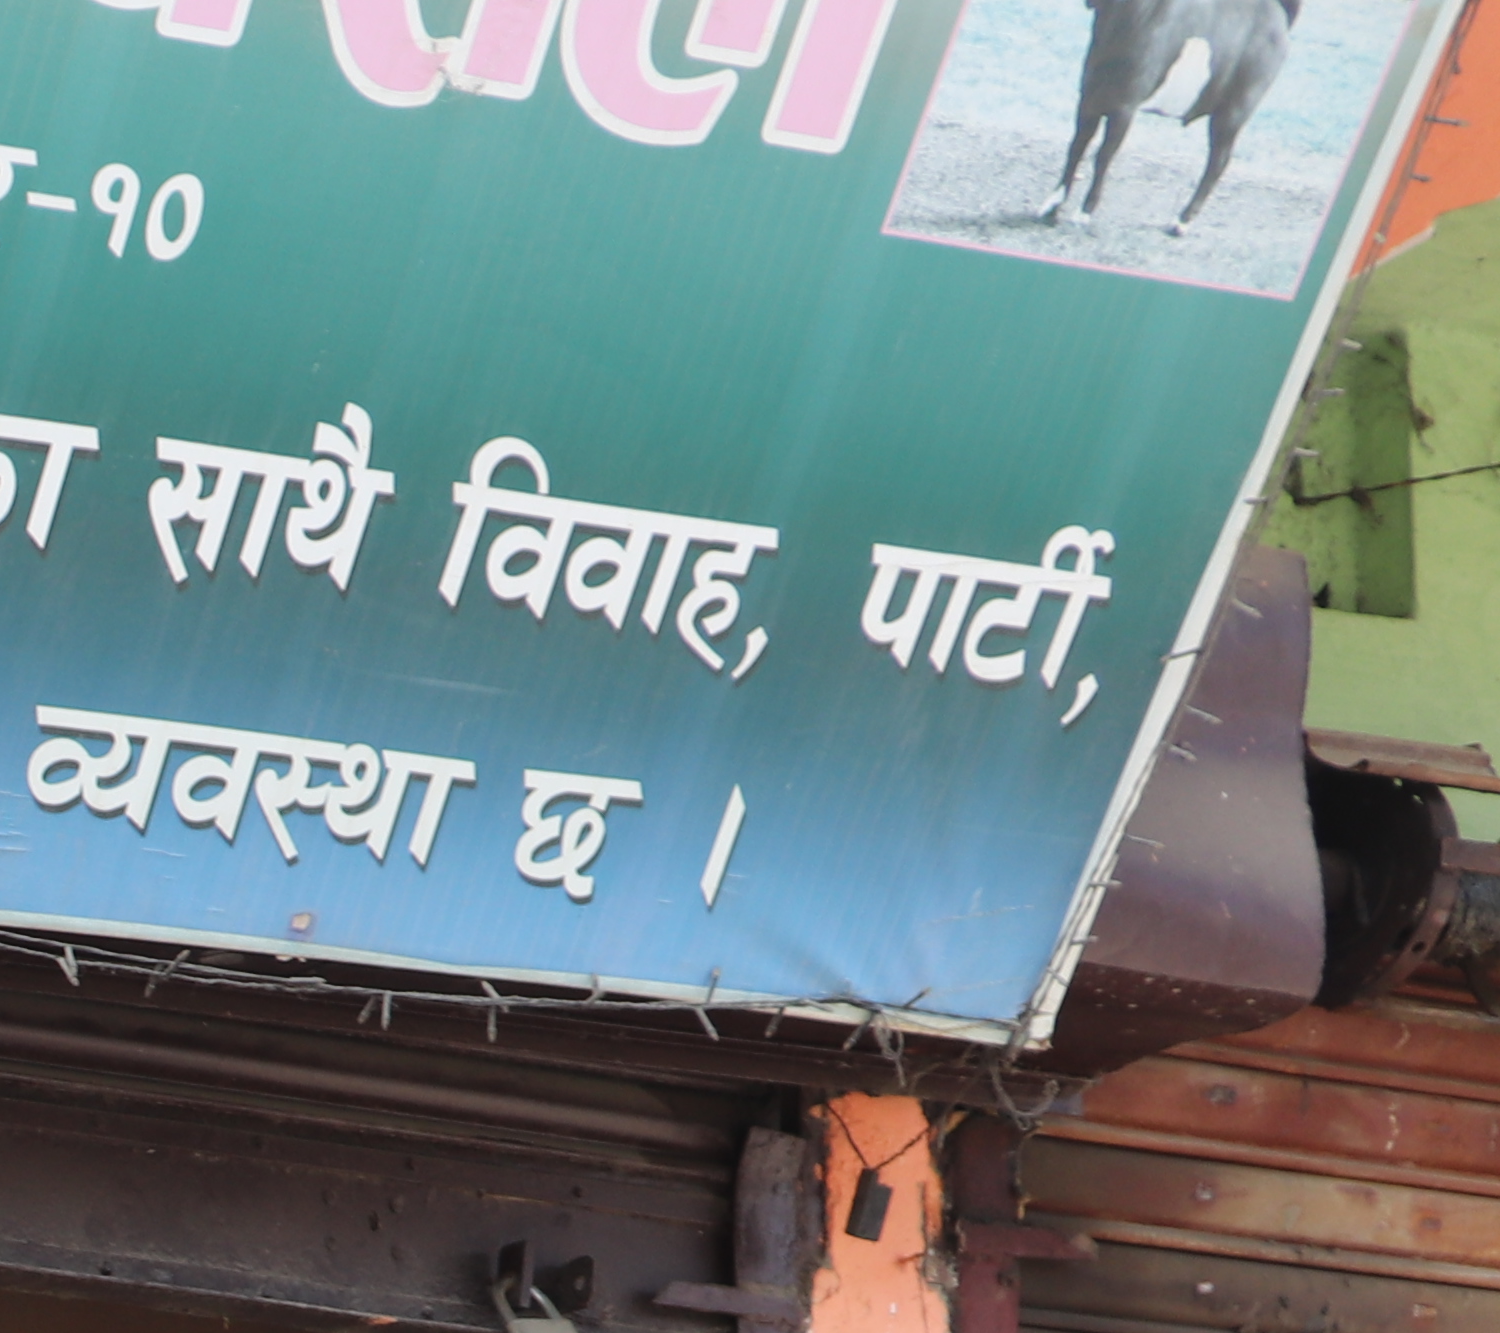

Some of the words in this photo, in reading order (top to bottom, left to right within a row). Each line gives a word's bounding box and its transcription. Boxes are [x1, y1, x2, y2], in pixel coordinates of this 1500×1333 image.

[148, 402, 395, 590] साथै
[439, 436, 779, 680] विवाह,
[861, 525, 1115, 725] पार्टी,
[26, 705, 476, 866] व्यवस्था
[514, 767, 643, 898] छ
